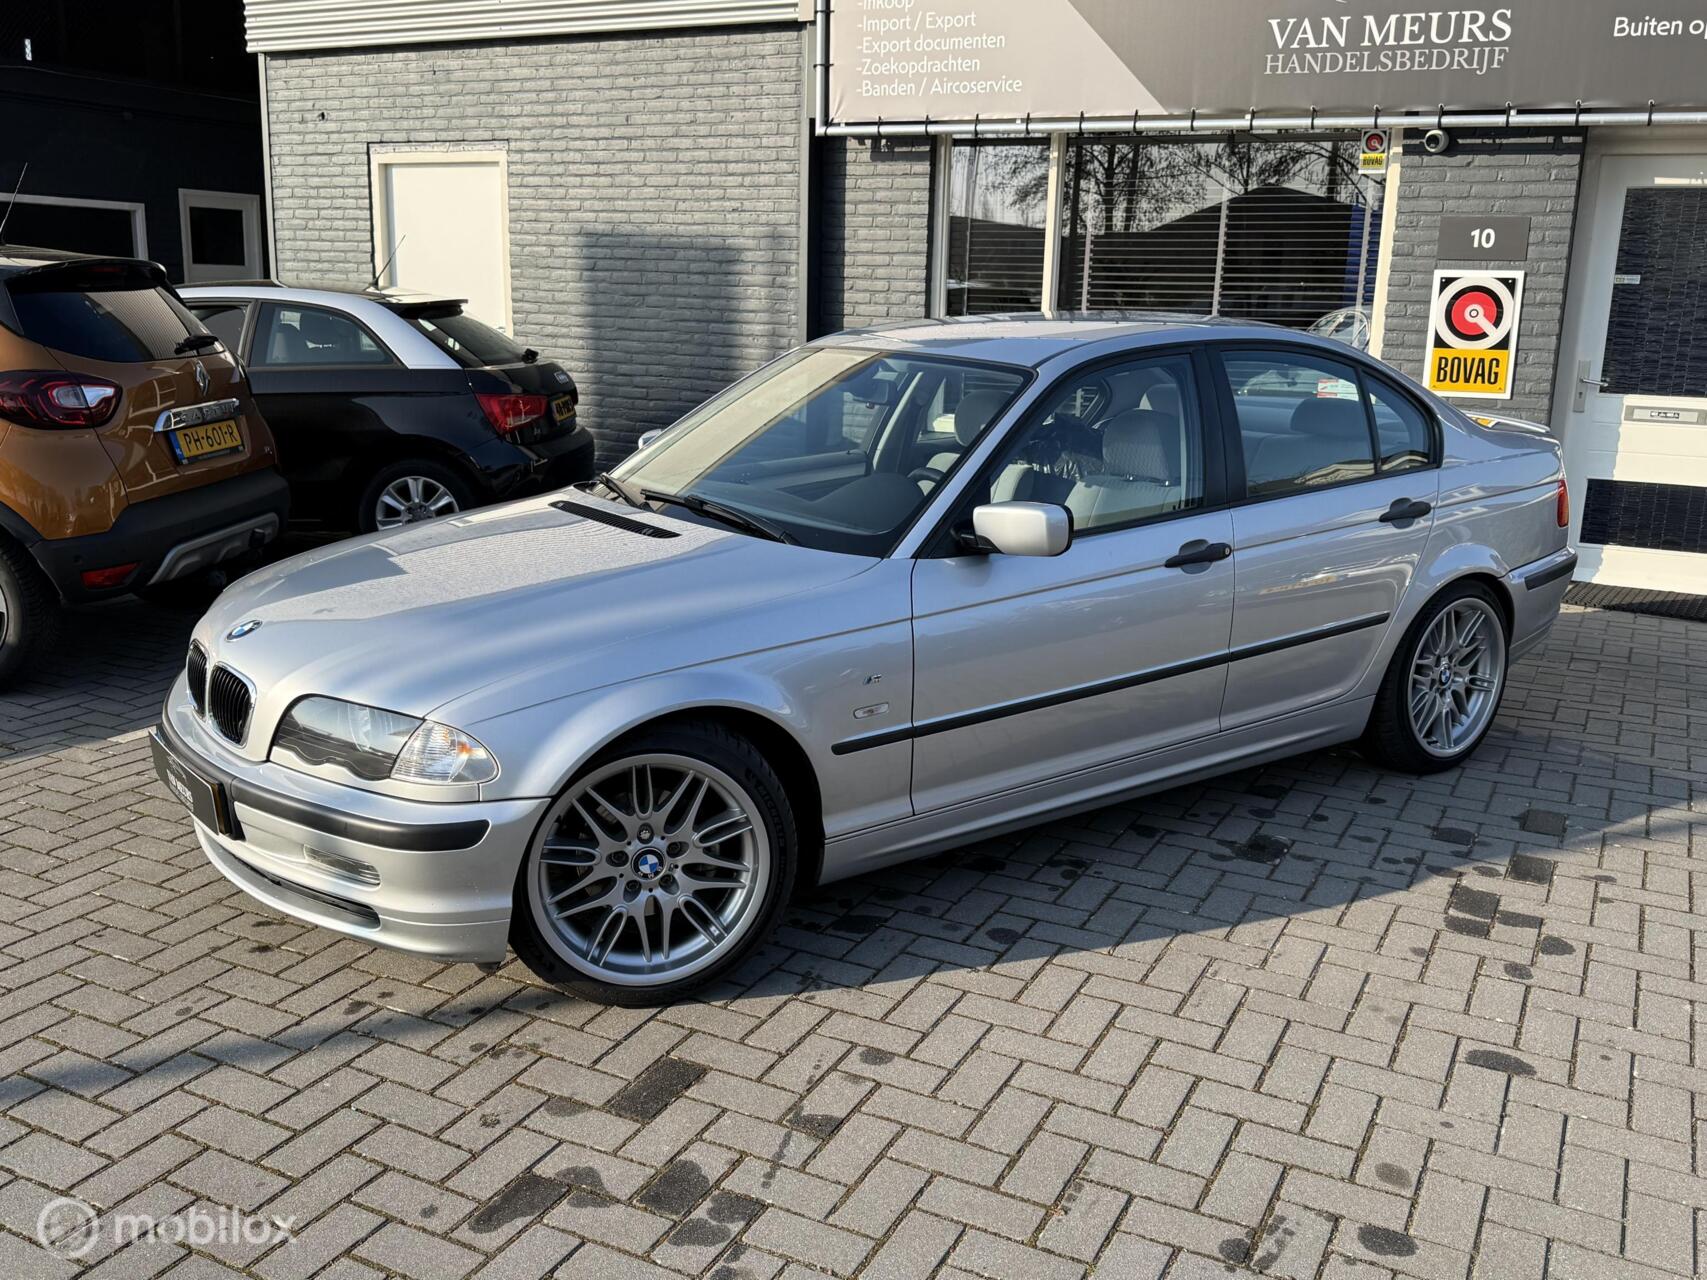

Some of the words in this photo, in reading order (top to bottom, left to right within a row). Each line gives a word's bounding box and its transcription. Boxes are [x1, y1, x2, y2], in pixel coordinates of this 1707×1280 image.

[856, 14, 911, 36] -Import
[926, 11, 977, 33] Export
[1268, 15, 1351, 50] VAN
[1361, 8, 1513, 47] MEURS
[1613, 15, 1683, 37] Buiten
[1689, 19, 1707, 40] o
[856, 36, 911, 57] -Export
[914, 32, 1006, 52] documenten
[856, 55, 981, 77] -Zoekopdrachten
[1264, 46, 1510, 75] HANDELSBEDRIJF
[856, 79, 916, 98] -Banden
[930, 77, 1023, 95] Aircoservice
[1362, 155, 1384, 166] BOVAG
[1470, 228, 1496, 249] 10
[1436, 356, 1500, 385] BOVAG
[183, 423, 238, 453] PH-601-R
